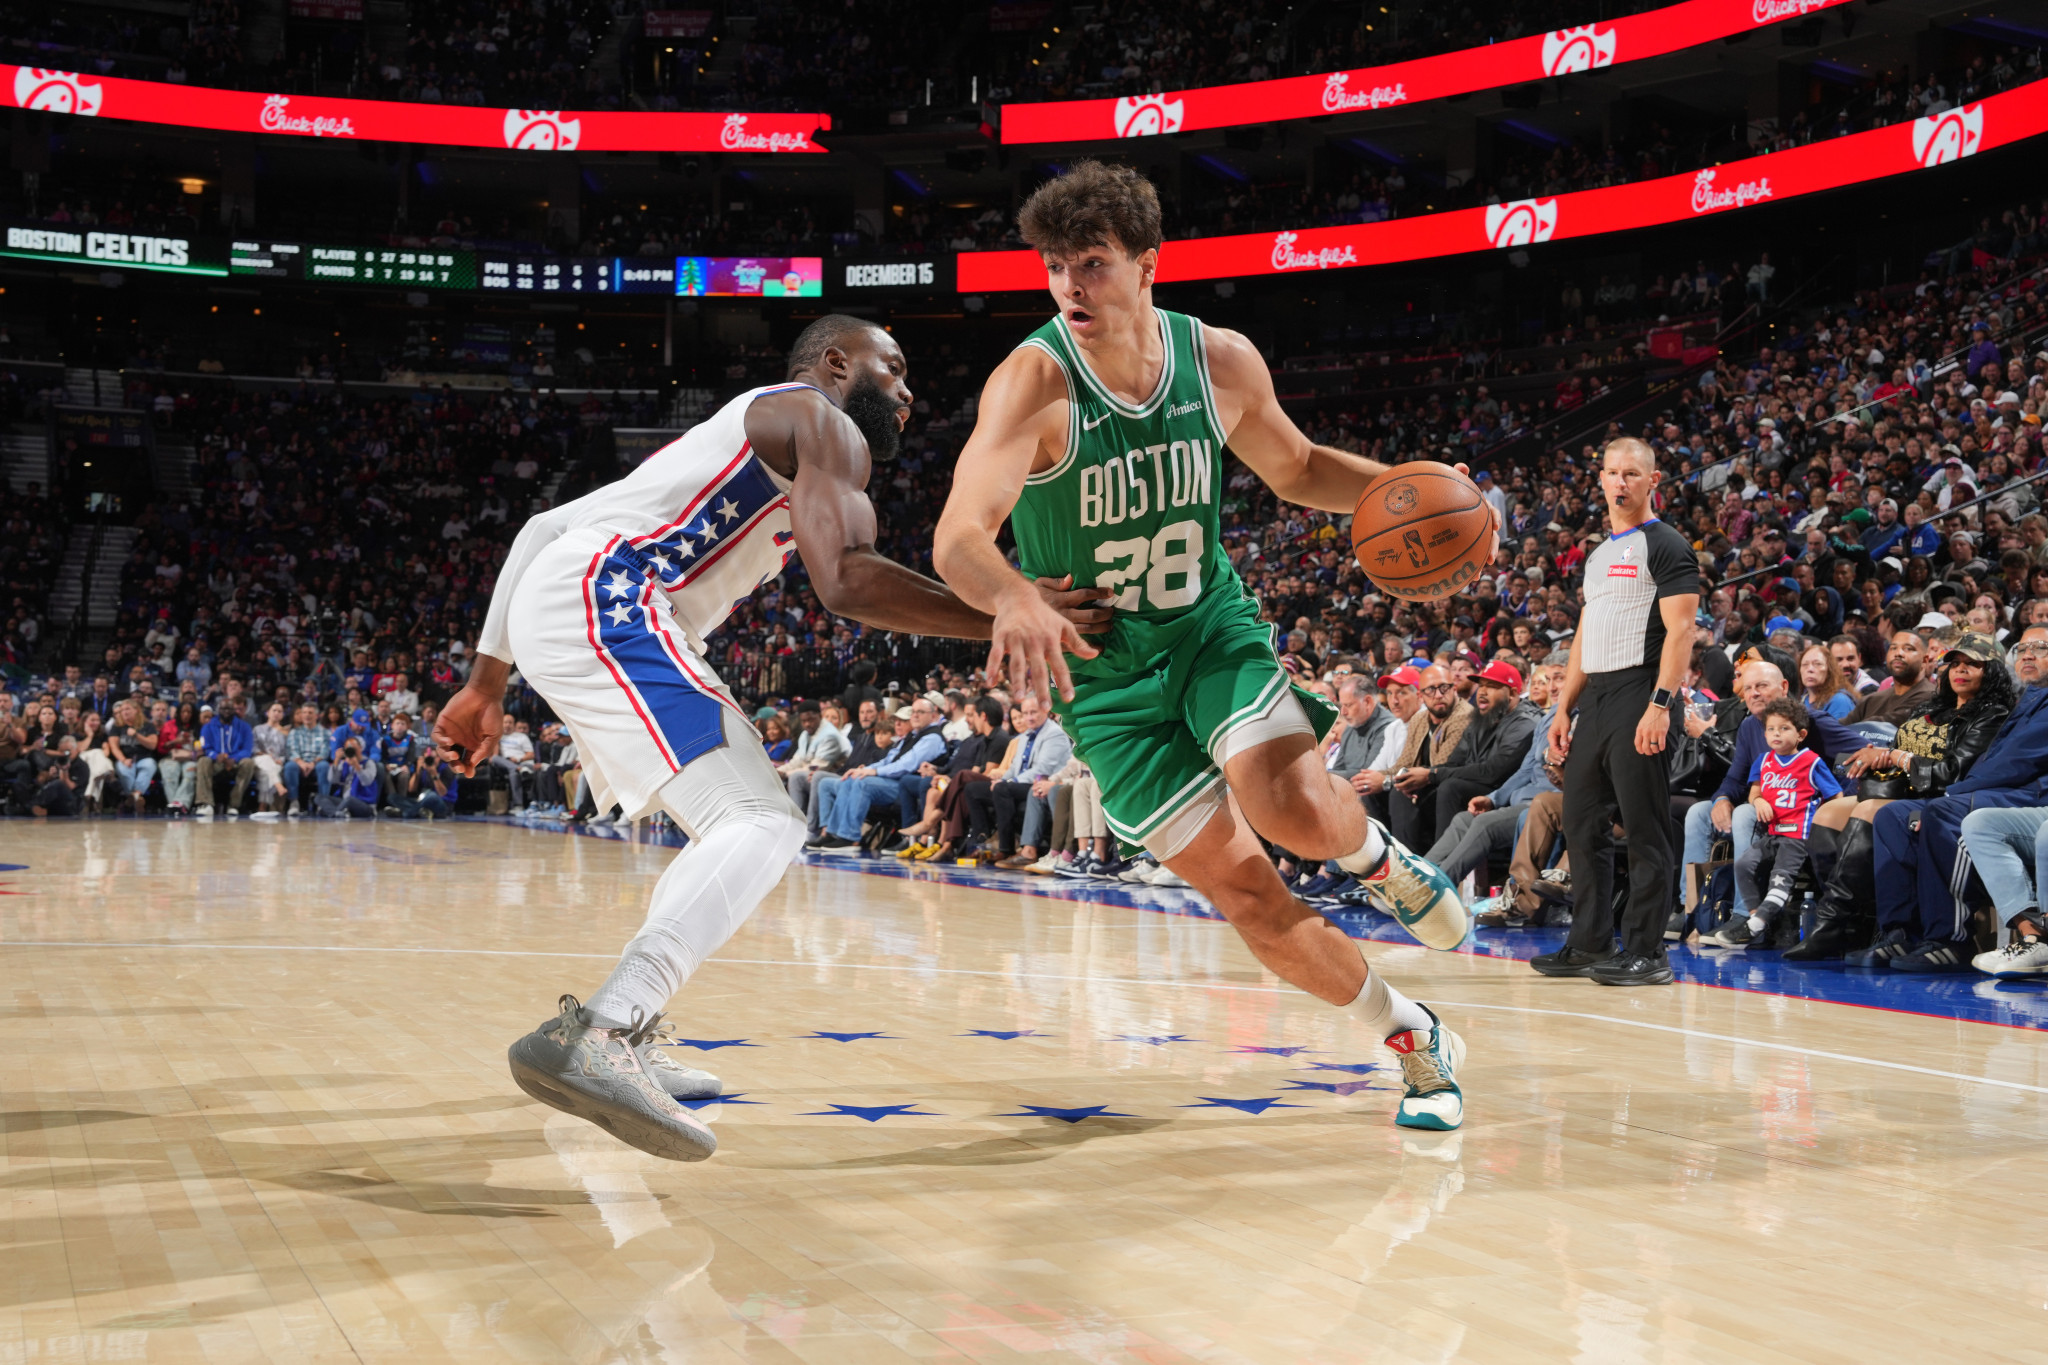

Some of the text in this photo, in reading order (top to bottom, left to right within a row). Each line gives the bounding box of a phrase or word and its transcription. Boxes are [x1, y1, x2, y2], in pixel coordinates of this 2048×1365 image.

[1322, 72, 1407, 112] Chick-fil-A
[259, 94, 354, 136] Chick-fil-A
[720, 113, 808, 152] Chick-fil-A
[1691, 169, 1773, 213] Chick-fil-A
[7, 227, 189, 266] BOSTON CELTICS
[312, 248, 357, 261] PLAYER
[380, 252, 397, 264] 27
[1271, 231, 1357, 270] Chick-fil-A
[313, 264, 356, 278] POINTS
[364, 267, 374, 279] 2
[383, 268, 393, 279] 7
[418, 270, 435, 282] 14
[440, 271, 450, 283] 7
[484, 262, 509, 275] PHI
[516, 263, 534, 275] 31
[572, 264, 583, 277] 5
[598, 265, 609, 277] 6
[652, 269, 674, 281] PM
[846, 263, 934, 287] DECEMBER 15
[483, 275, 510, 288] BOS
[516, 277, 534, 289] 32
[543, 278, 560, 290] 15
[572, 279, 583, 291] 4
[1166, 400, 1203, 419] Amica
[1080, 439, 1212, 528] BOSTON
[1092, 519, 1204, 612] 28
[1608, 567, 1637, 576] Emirates
[1762, 771, 1799, 792] Phila
[1775, 789, 1797, 808] 21
